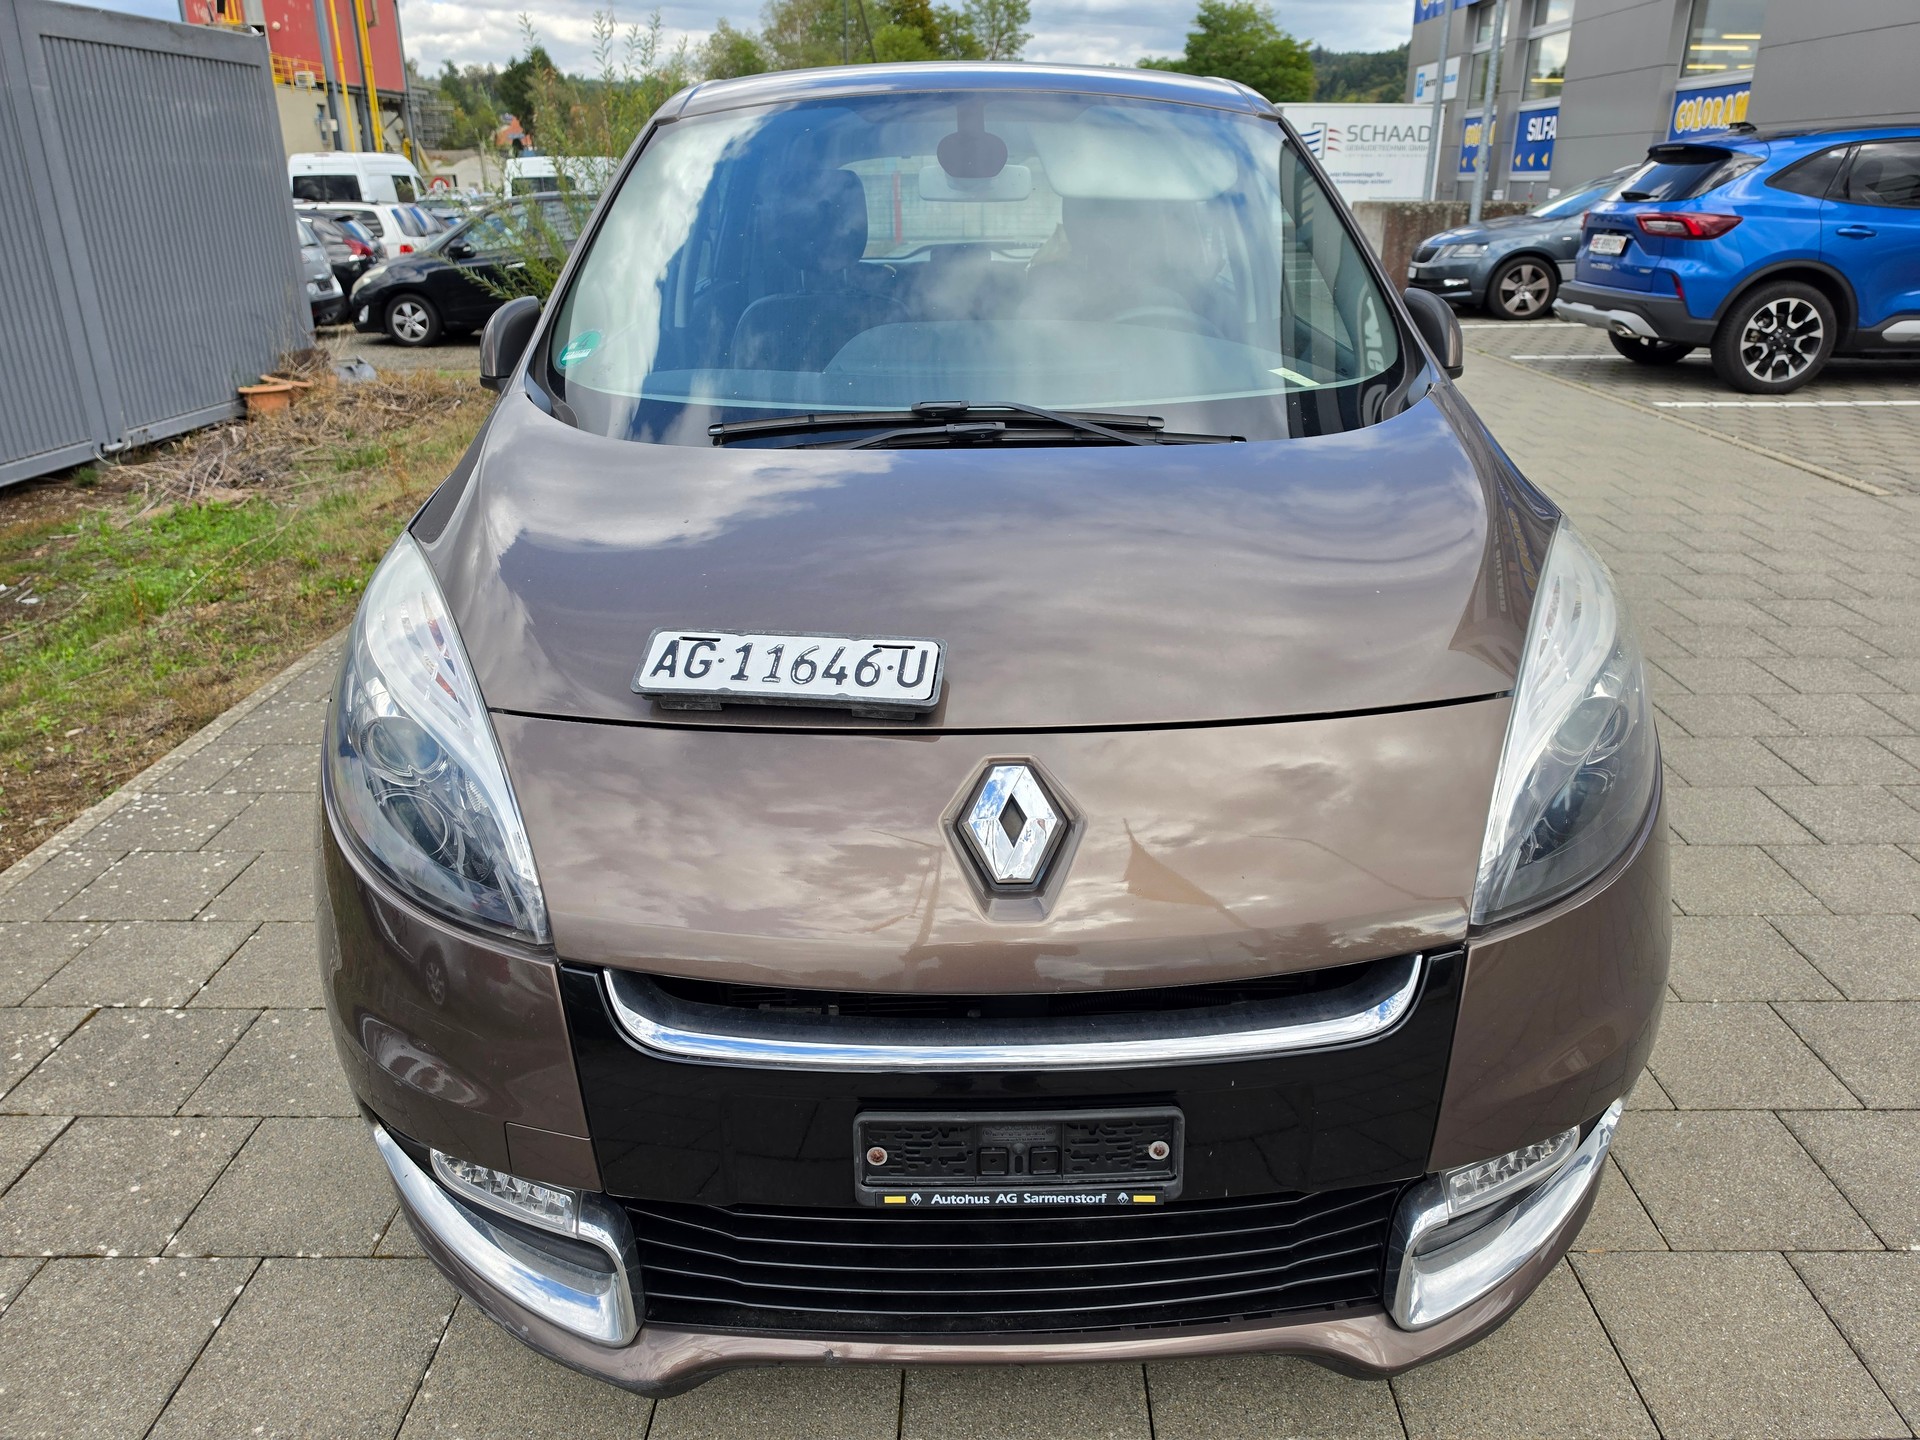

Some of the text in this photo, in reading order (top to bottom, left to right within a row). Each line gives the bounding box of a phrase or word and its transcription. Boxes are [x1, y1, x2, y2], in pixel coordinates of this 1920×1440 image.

[1346, 124, 1431, 142] SCHAAD
[930, 1193, 1107, 1205] Autohus AG Sarmenstorf
